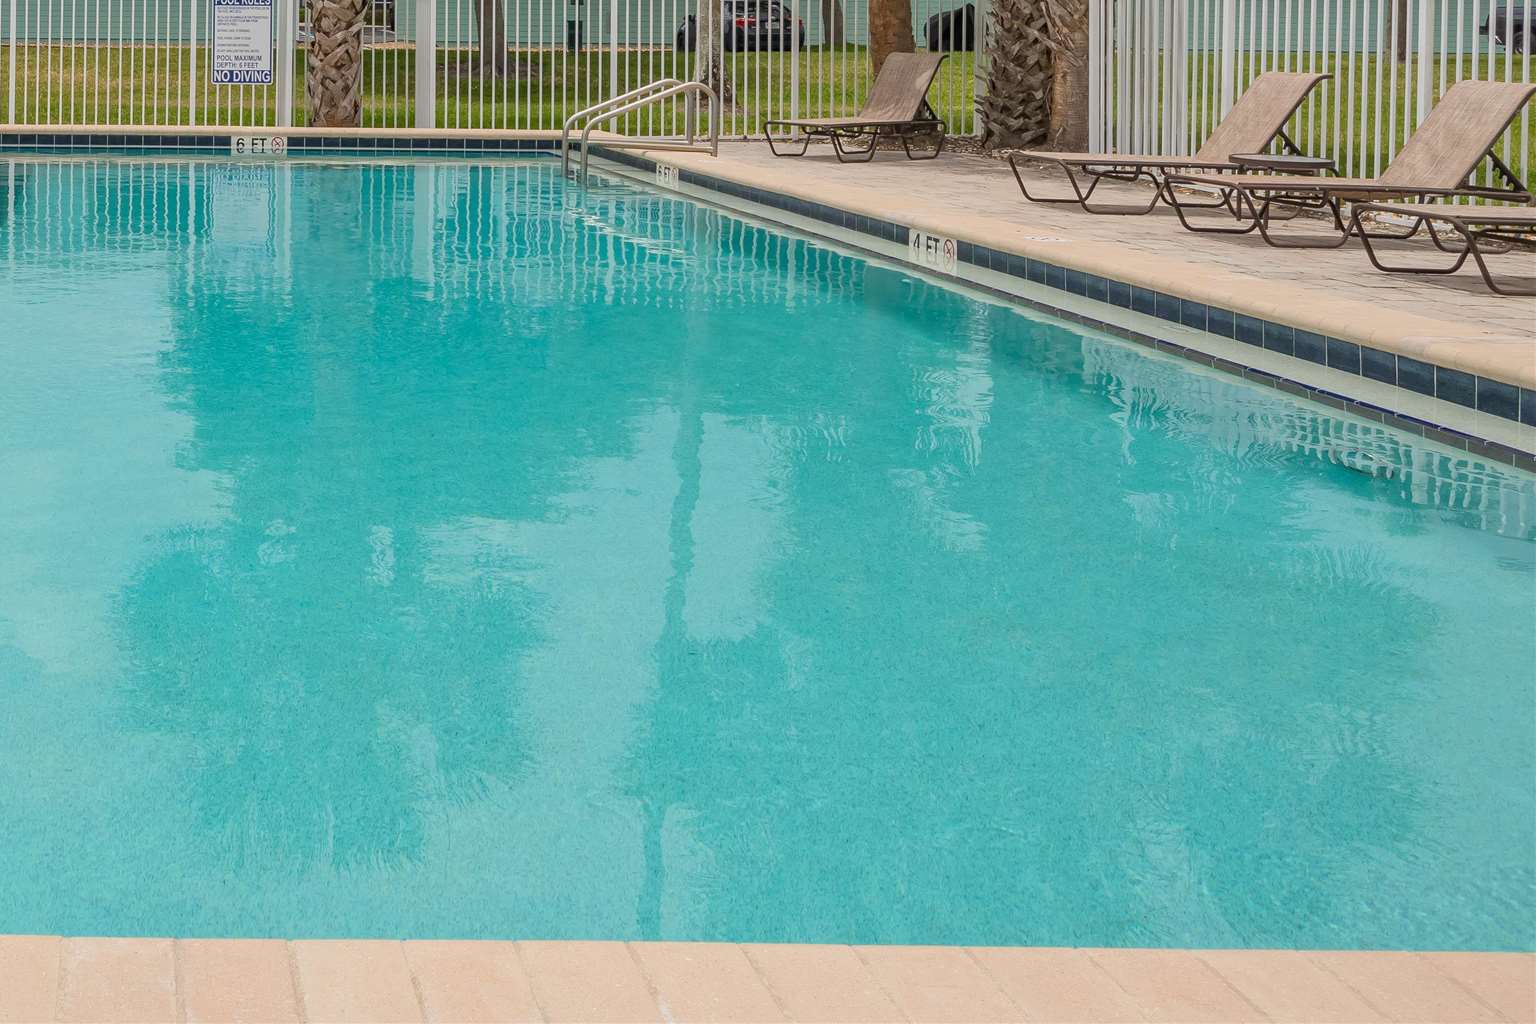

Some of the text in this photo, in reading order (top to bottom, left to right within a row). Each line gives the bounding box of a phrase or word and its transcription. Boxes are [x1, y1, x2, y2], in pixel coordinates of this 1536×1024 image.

[214, 71, 271, 82] NO DIVING
[251, 137, 267, 150] FT
[926, 235, 940, 254] FT
